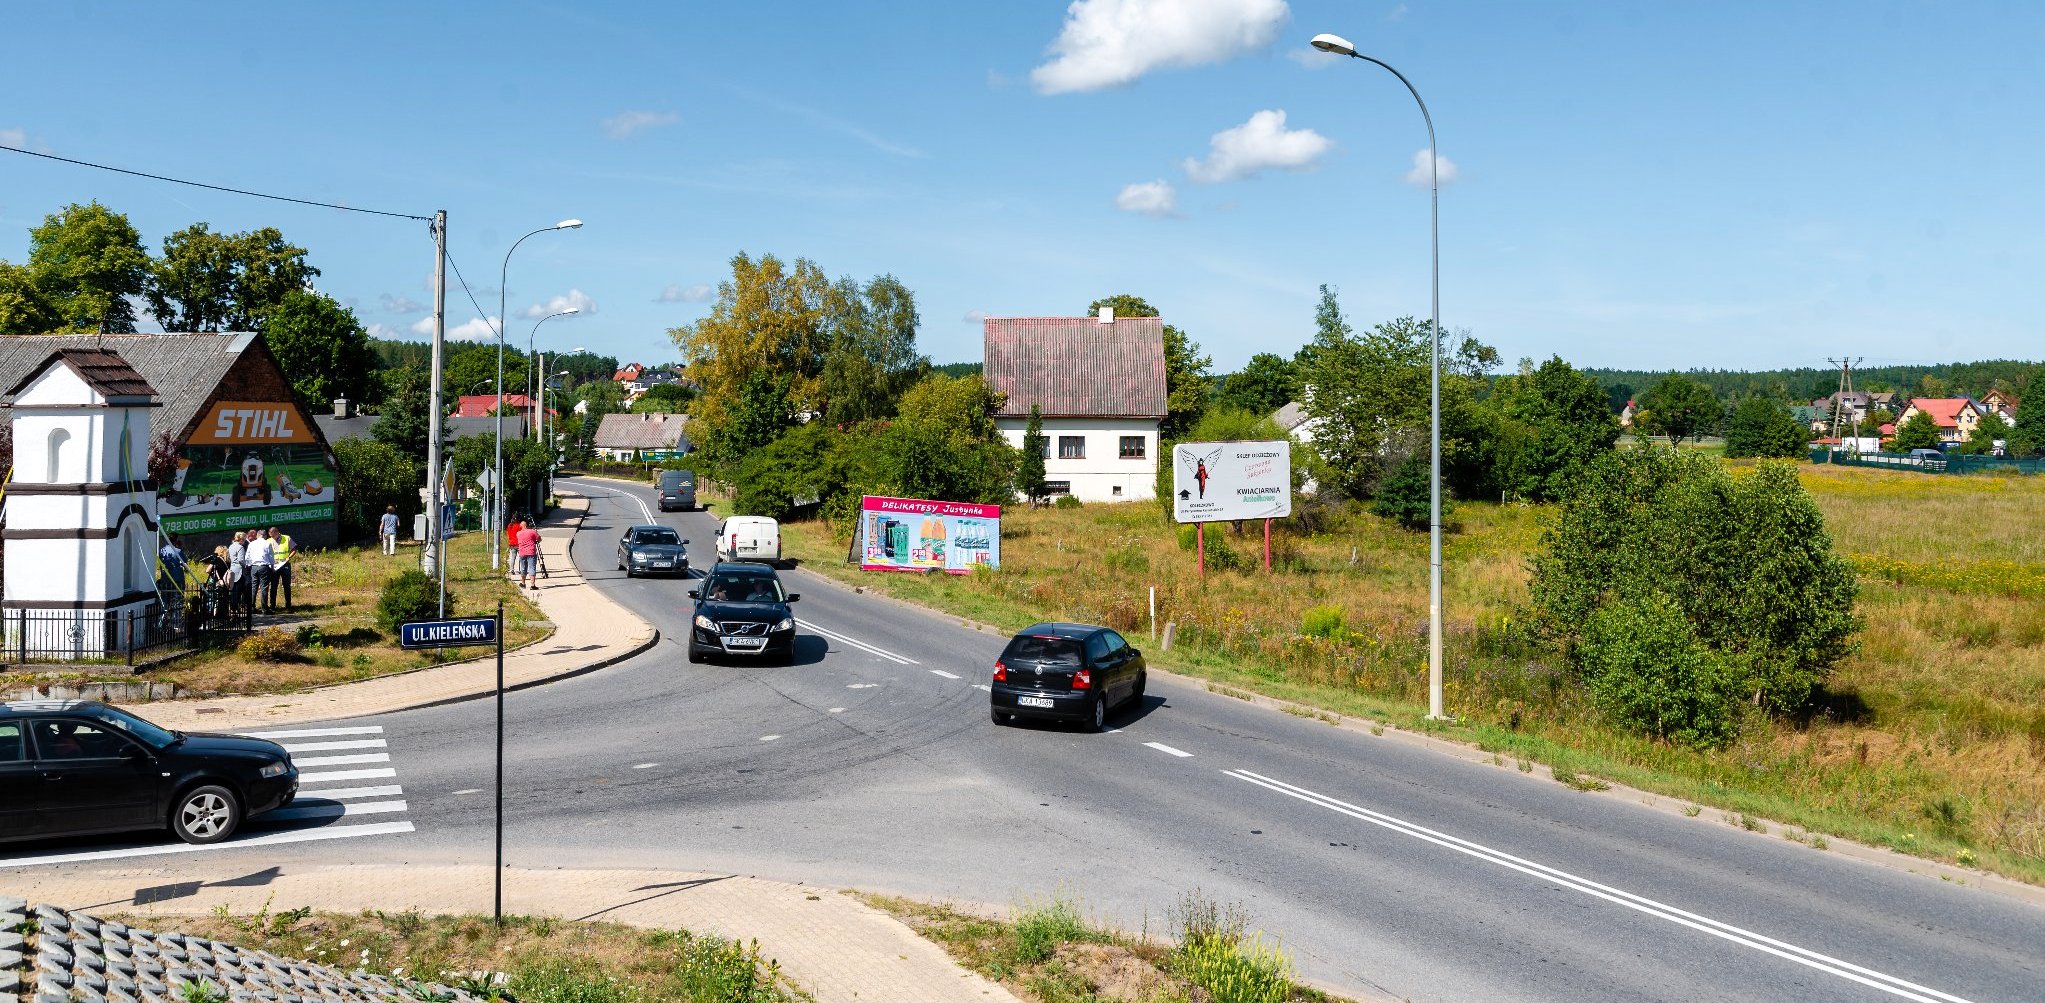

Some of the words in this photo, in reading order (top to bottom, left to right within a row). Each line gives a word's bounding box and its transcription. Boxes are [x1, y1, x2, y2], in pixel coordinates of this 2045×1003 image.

[214, 409, 293, 438] STIHL
[1236, 486, 1281, 495] KWIACIARNIA
[881, 501, 938, 513] DELIKATESY
[942, 504, 983, 516] Justynka
[165, 521, 182, 532] 792
[183, 520, 200, 530] 000
[200, 518, 217, 529] 664
[412, 621, 487, 642] UL.KIELEŃSKA
